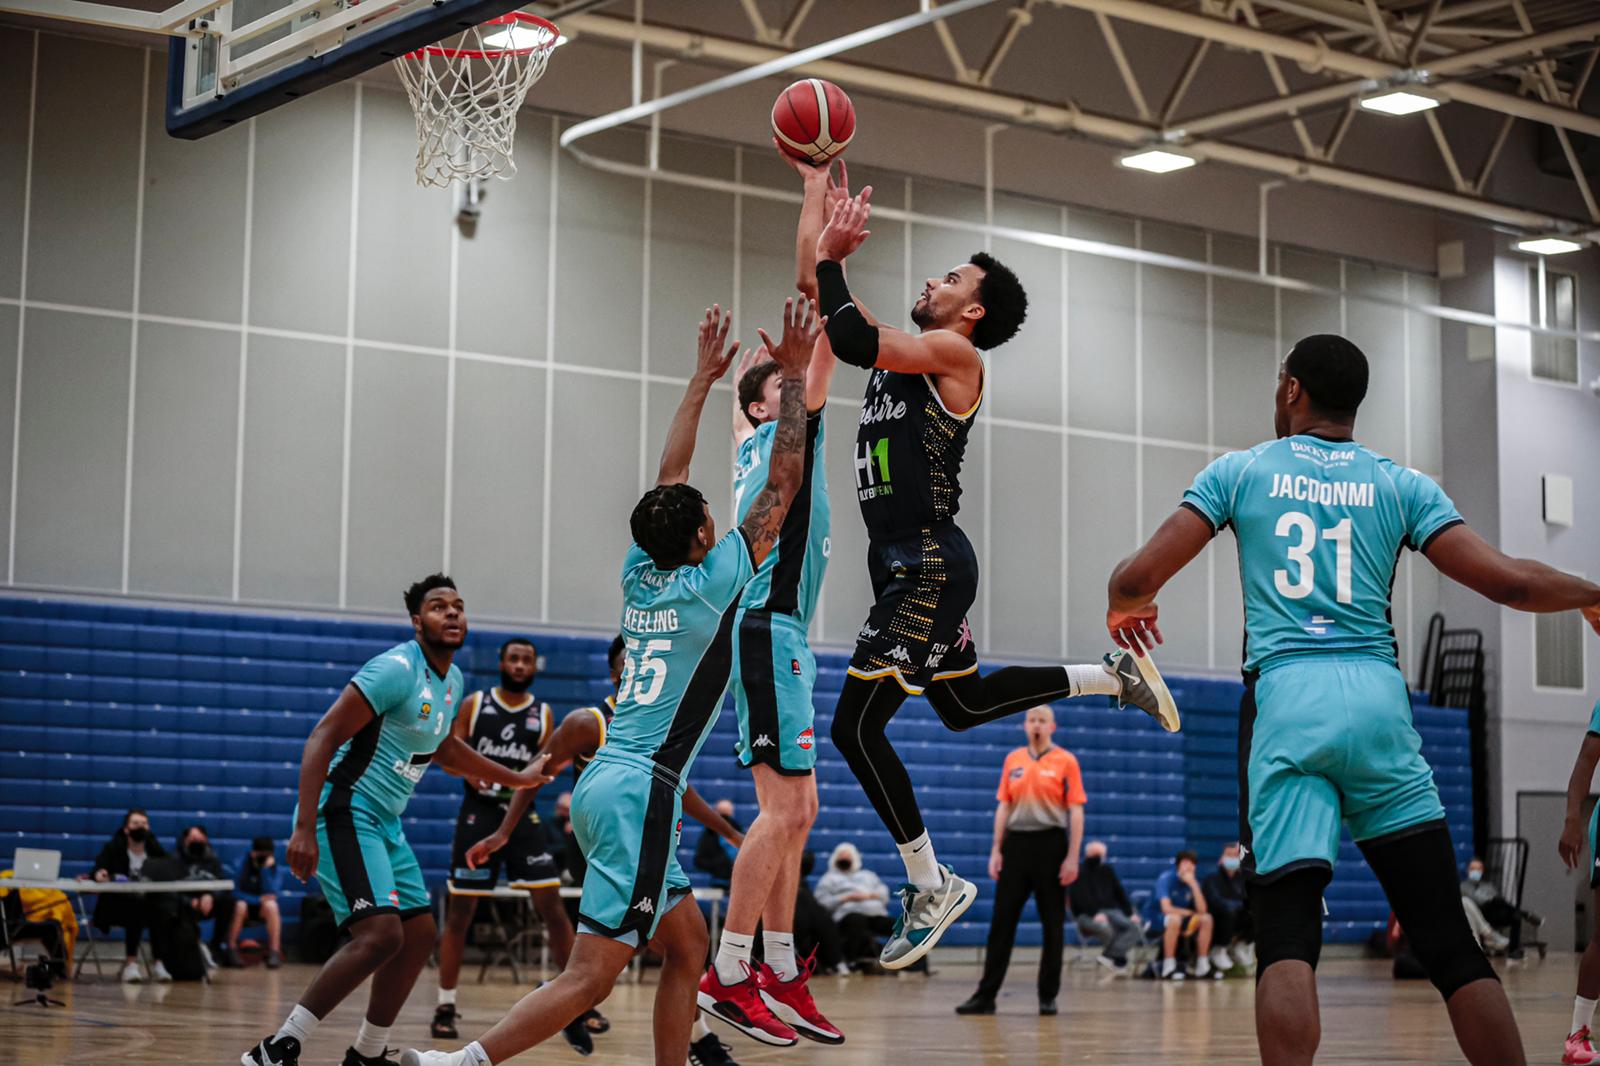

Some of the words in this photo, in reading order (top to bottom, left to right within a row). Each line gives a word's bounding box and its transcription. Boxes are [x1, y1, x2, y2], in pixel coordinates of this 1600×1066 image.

[1273, 511, 1353, 605] 31
[624, 606, 678, 632] KEELING
[434, 712, 444, 735] 3
[500, 723, 516, 741] 6
